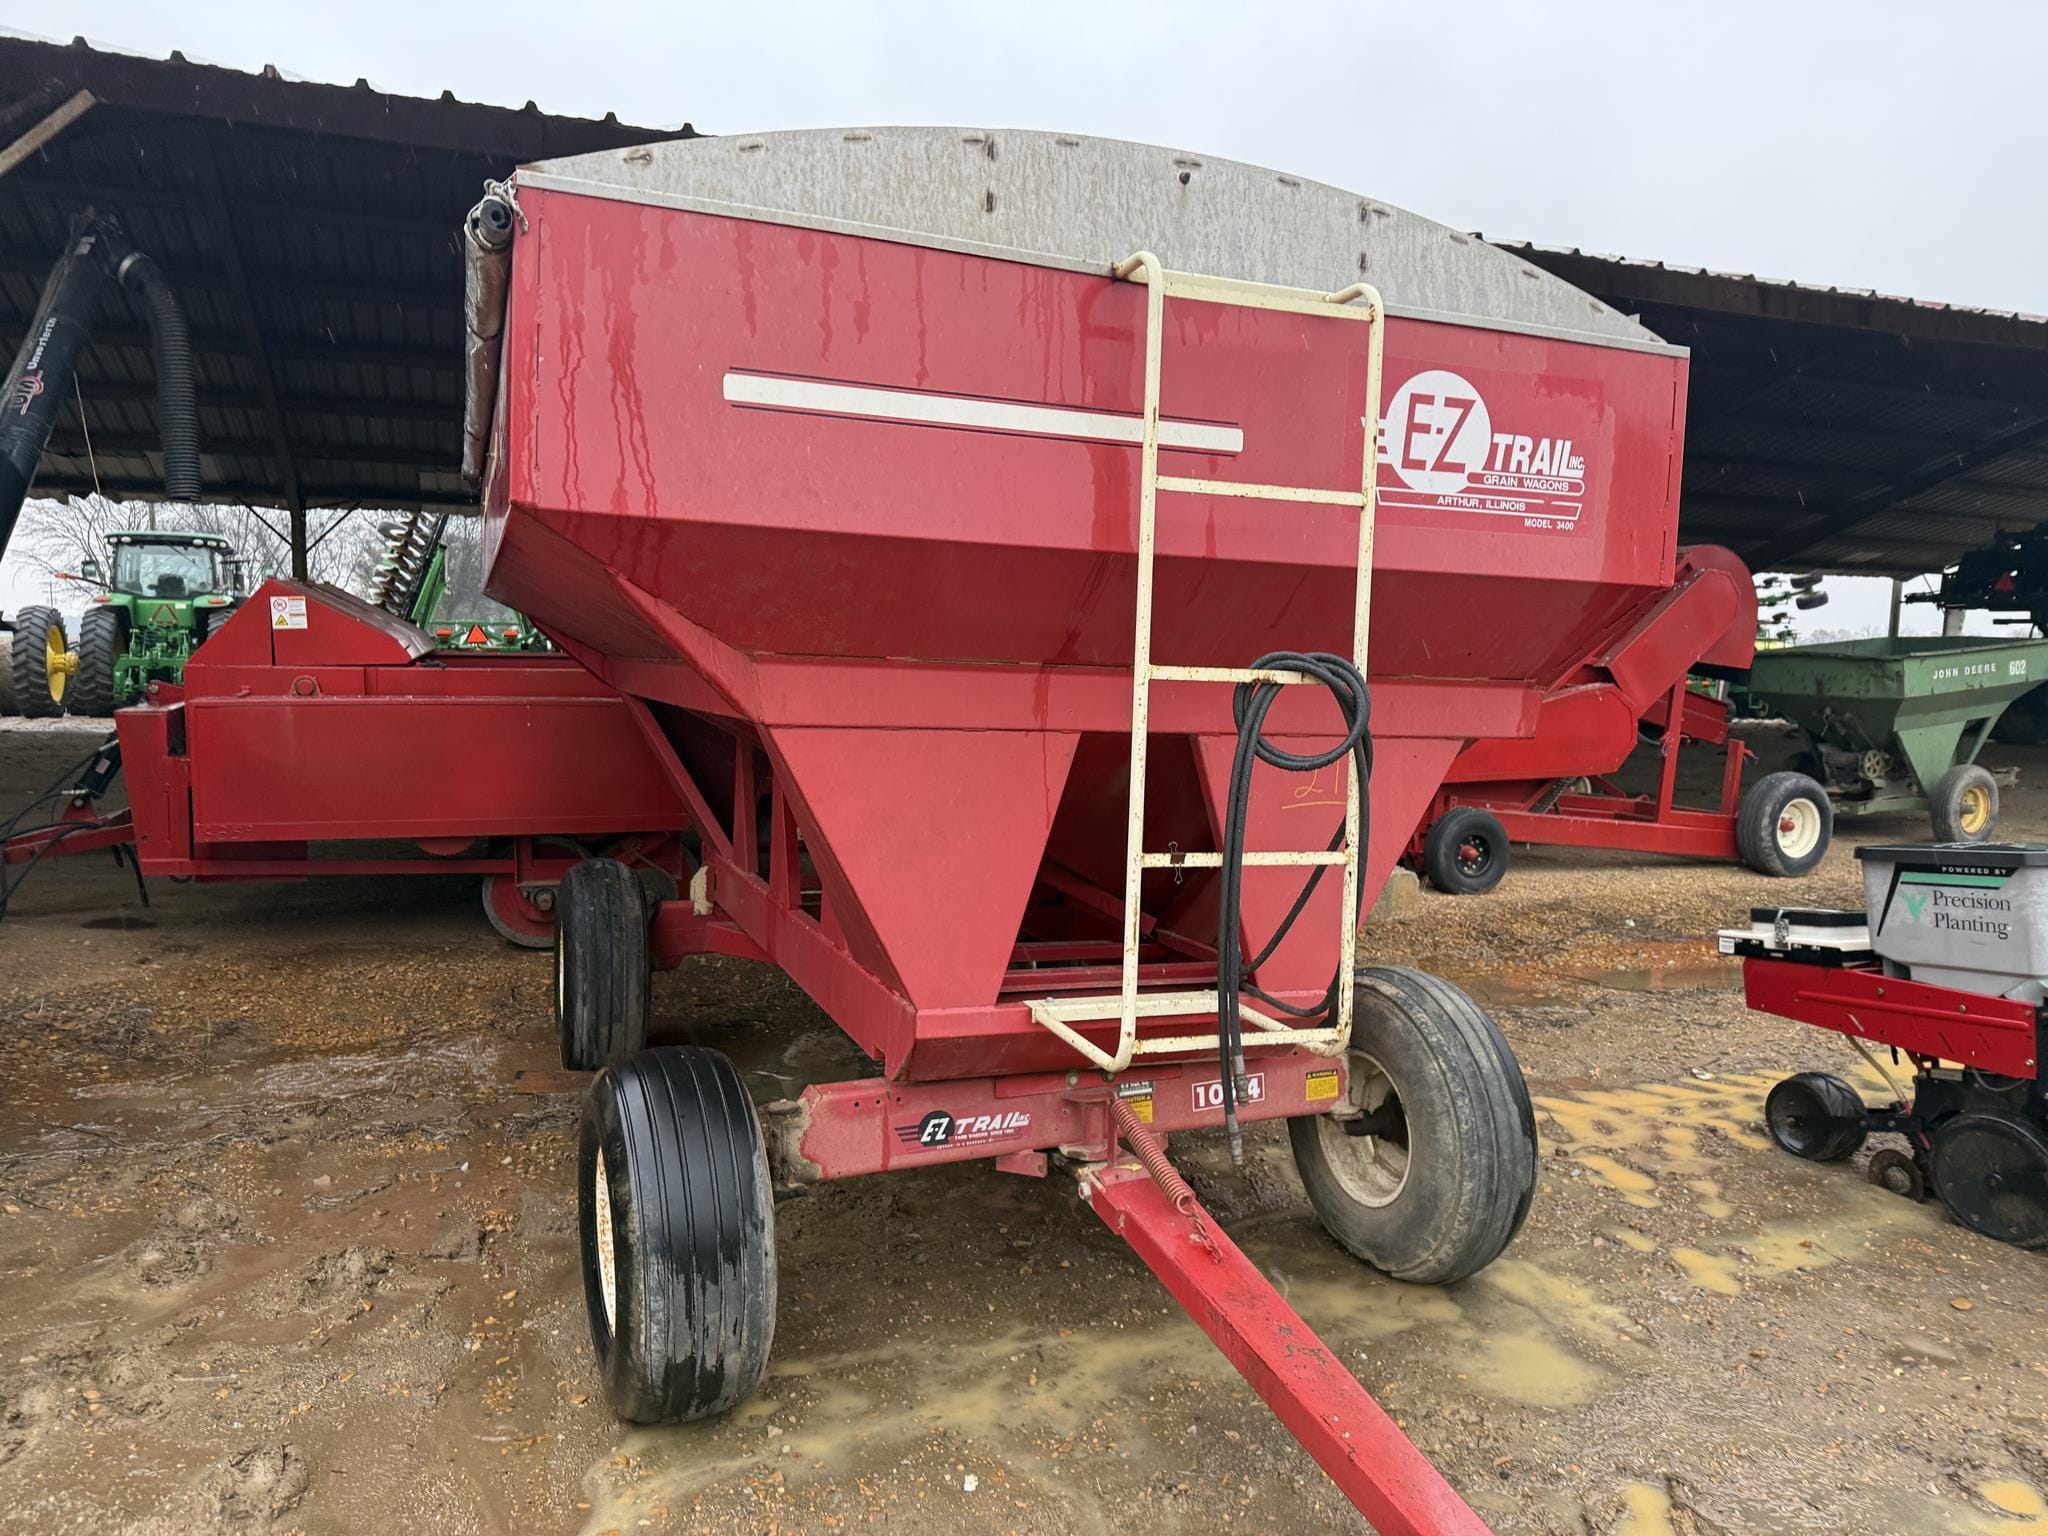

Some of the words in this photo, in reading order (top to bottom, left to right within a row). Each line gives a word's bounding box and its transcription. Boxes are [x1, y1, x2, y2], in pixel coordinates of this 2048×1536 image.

[1492, 432, 1585, 478] TRAIL
[1483, 474, 1518, 488] GRAIN
[1523, 478, 1569, 492] WAGONS
[1437, 495, 1482, 509] ARTHUR,
[1485, 498, 1526, 512] ILLINOIS
[1524, 518, 1552, 529] MODEL
[1556, 520, 1575, 531] 3400
[1933, 667, 1959, 680] JOHN
[1964, 663, 1997, 676] DEERE
[2008, 659, 2028, 676] 602
[1941, 865, 1989, 875] POWERED
[1994, 868, 2007, 876] BY
[1932, 890, 2011, 912] Precision
[1934, 912, 2010, 940] Planting
[1196, 1077, 1261, 1107] 104
[955, 1112, 1029, 1135] TRAIL
